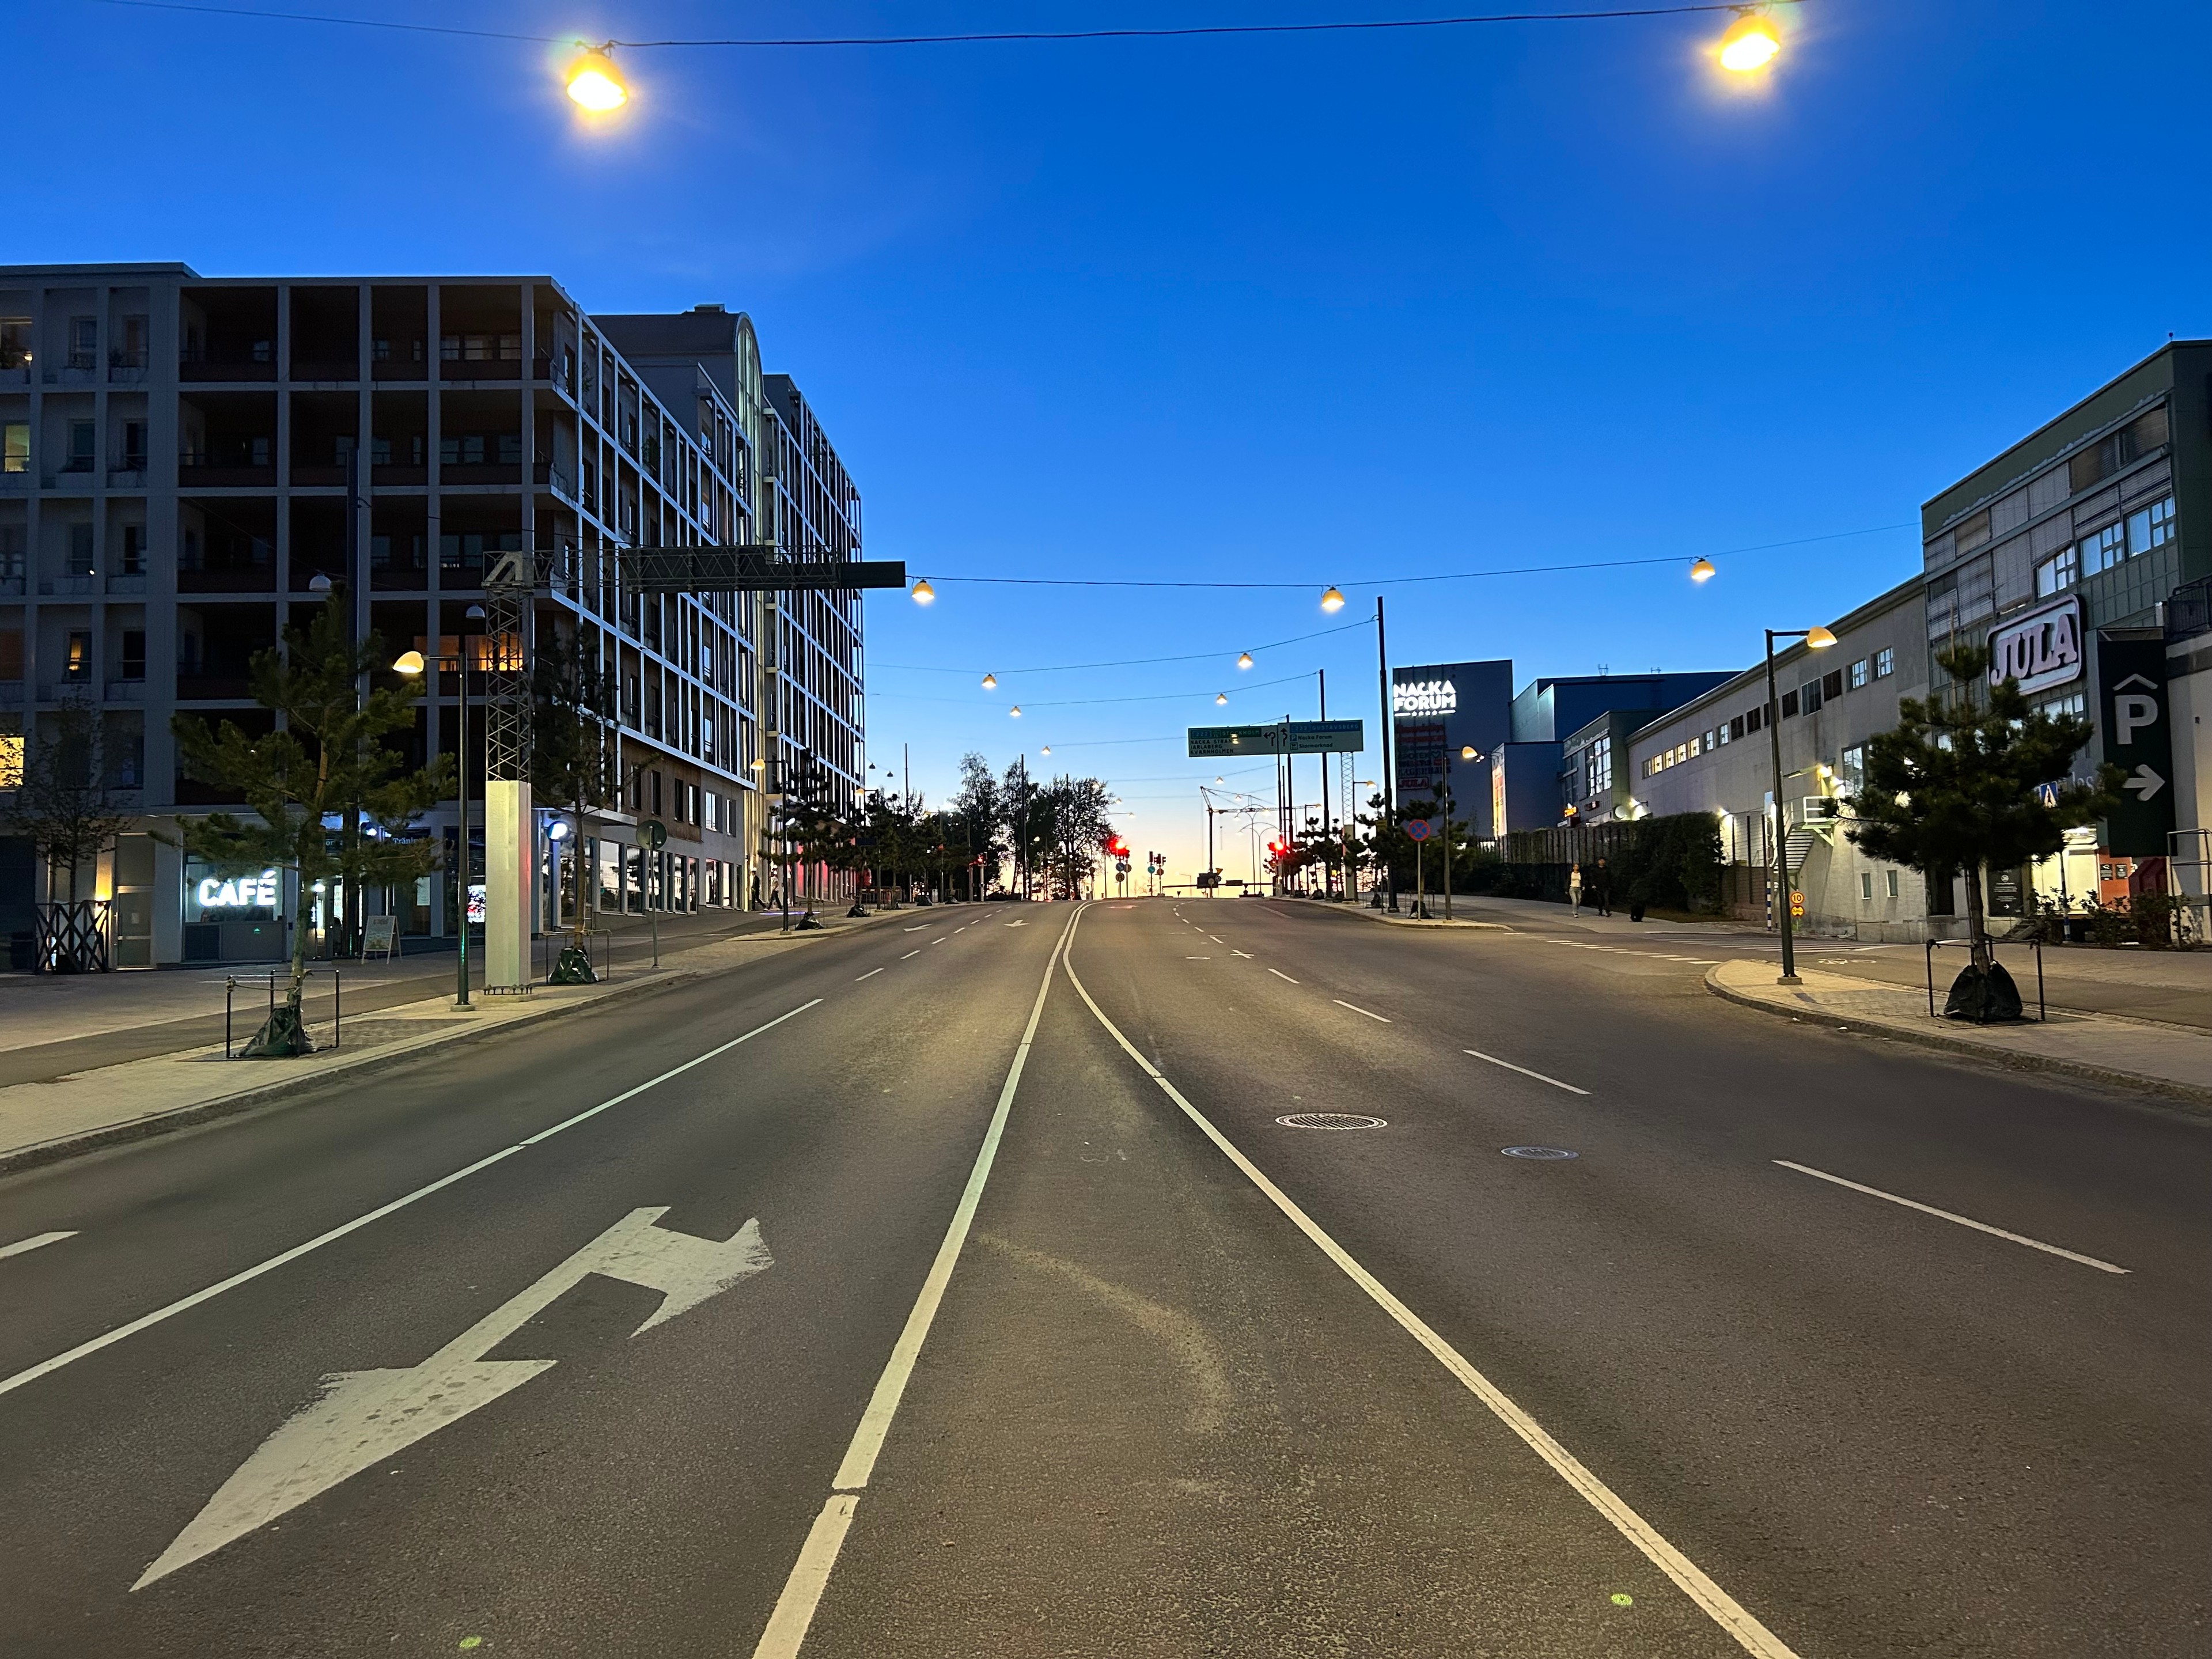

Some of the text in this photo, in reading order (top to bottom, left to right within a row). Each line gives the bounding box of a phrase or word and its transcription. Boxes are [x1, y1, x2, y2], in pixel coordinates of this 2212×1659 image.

[1990, 614, 2077, 686] JULA
[1393, 680, 1456, 697] NACKA
[1393, 694, 1456, 712] FORUM
[2115, 694, 2158, 745] P
[1398, 779, 1427, 787] JULA
[198, 870, 276, 907] CAFÉ
